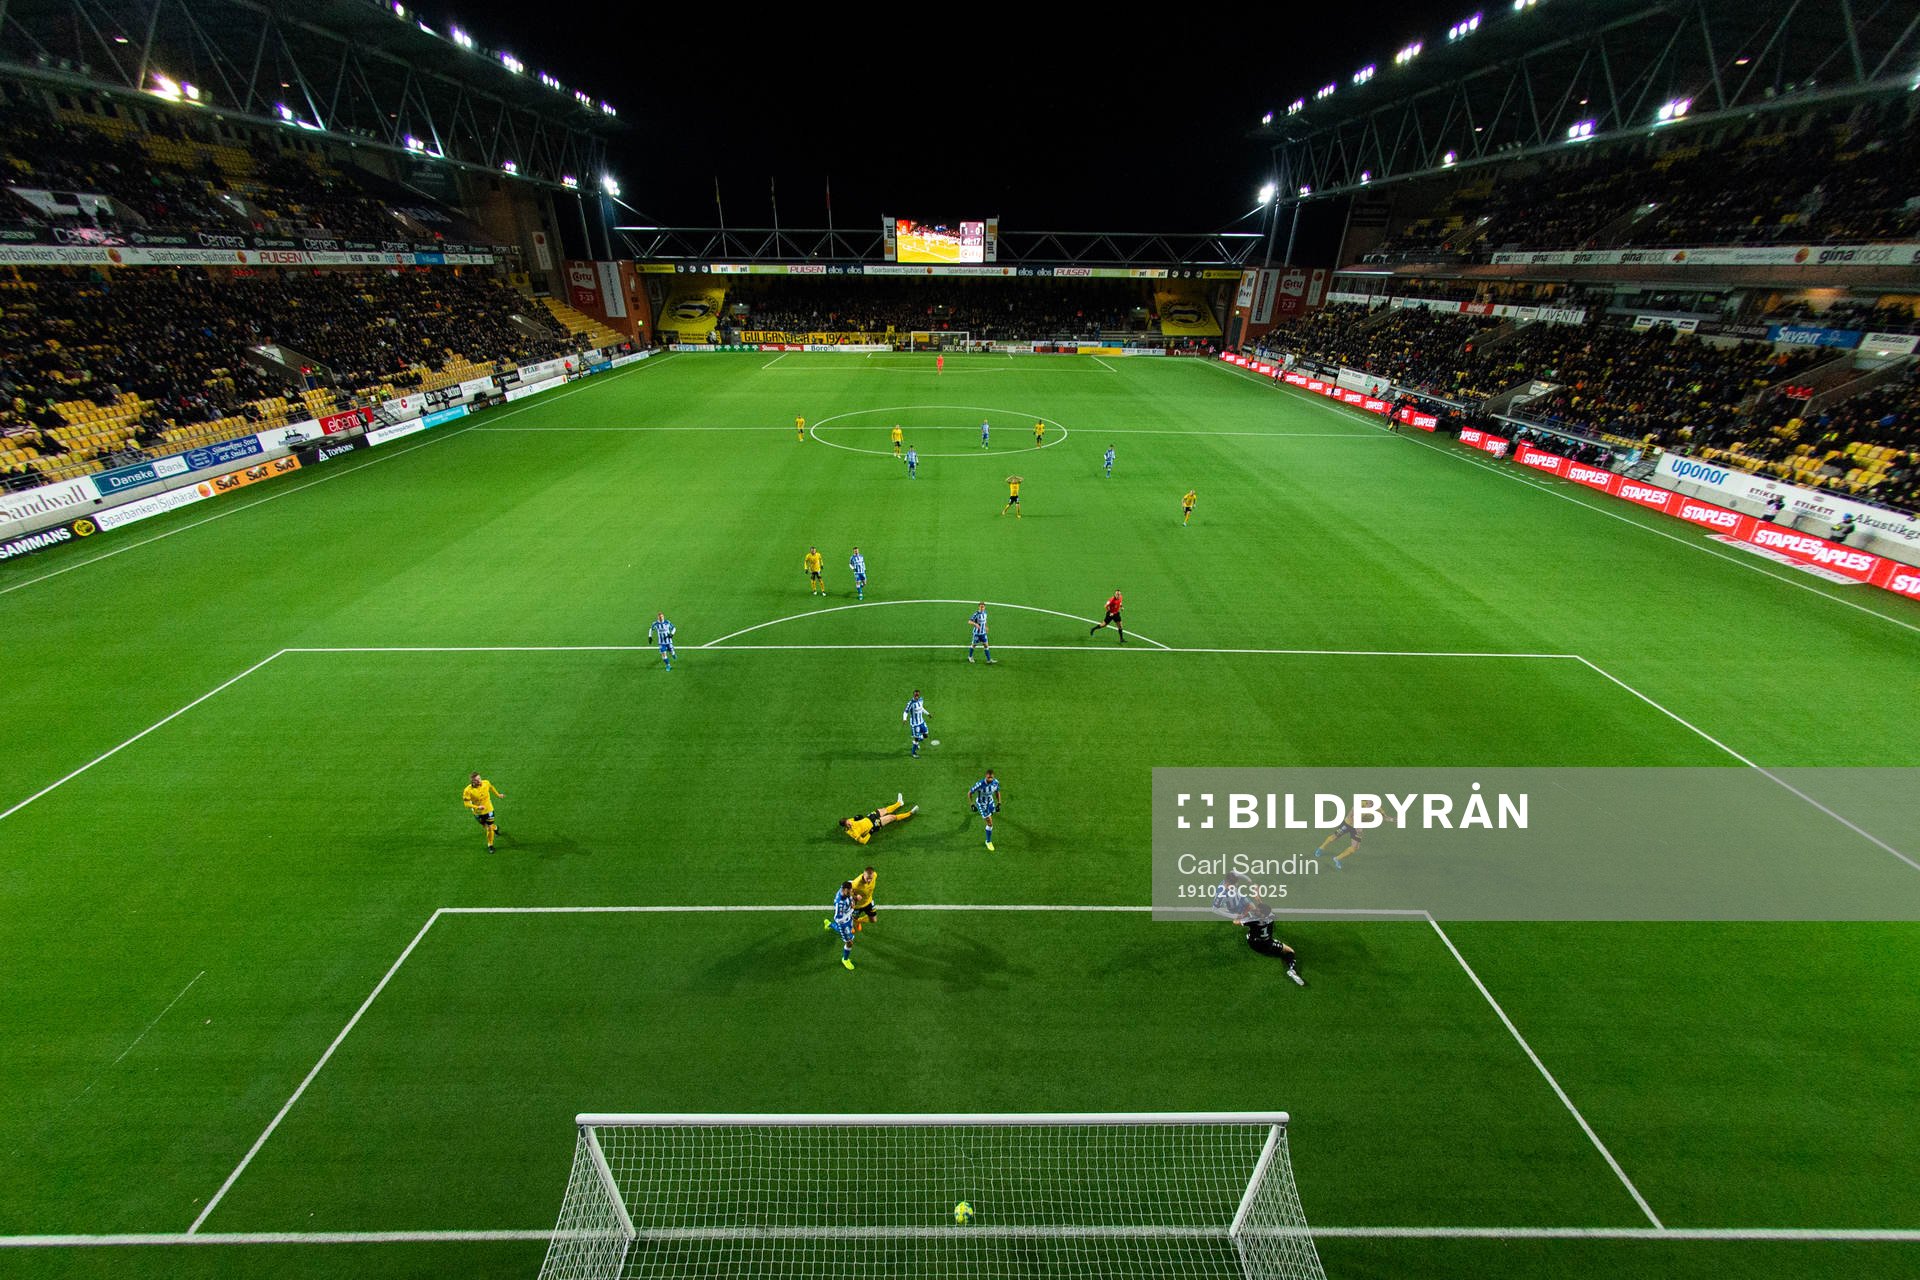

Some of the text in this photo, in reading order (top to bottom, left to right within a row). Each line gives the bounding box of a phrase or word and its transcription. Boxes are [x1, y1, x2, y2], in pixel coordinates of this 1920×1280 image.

[260, 251, 302, 264] PULSEN
[789, 266, 824, 274] PULSEN
[1056, 268, 1091, 276] PULSEN
[1543, 310, 1580, 322] AVENTI
[1776, 325, 1822, 345] SILVENT
[1523, 451, 1560, 469] STAPLES
[109, 460, 185, 488] Danske Bank
[1569, 466, 1610, 486] STAPLES
[1671, 459, 1730, 485] uponor
[1620, 484, 1670, 506] STAPLES
[100, 502, 159, 528] Sparbanken
[1682, 504, 1739, 528] STAPLES
[0, 527, 72, 559] SAMMANS
